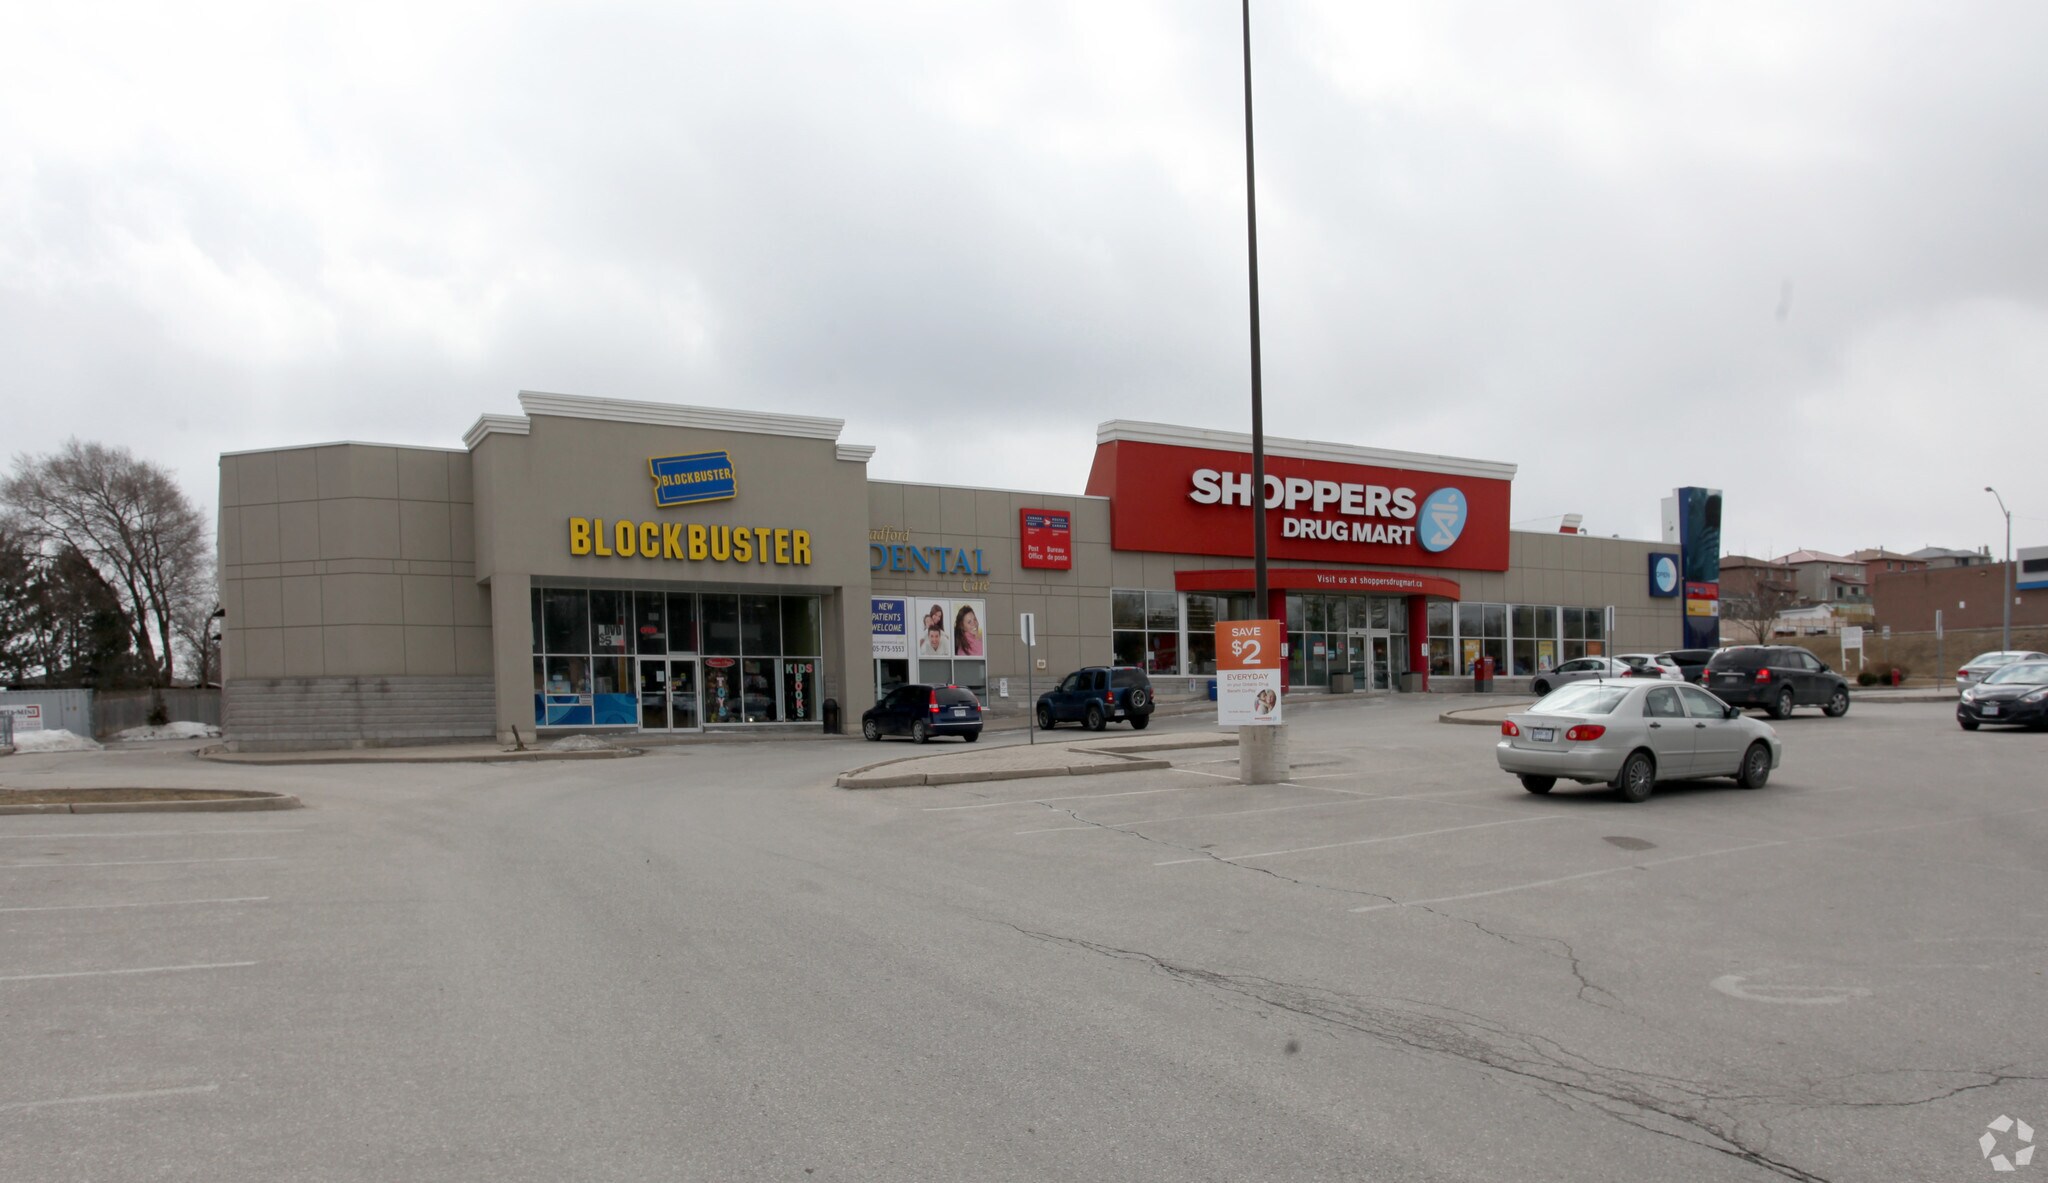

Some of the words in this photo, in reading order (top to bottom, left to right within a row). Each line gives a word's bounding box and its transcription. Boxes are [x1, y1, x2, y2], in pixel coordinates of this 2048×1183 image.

[662, 468, 731, 487] BLOCKBUSTER
[1190, 469, 1417, 519] SHOPPERS
[869, 525, 912, 542] adford
[1283, 518, 1349, 541] DRUG
[1351, 523, 1415, 545] MART
[570, 517, 812, 565] BLOCKBUSTER
[1028, 544, 1039, 552] Post
[1028, 552, 1043, 560] Office
[1047, 545, 1064, 553] Bureau
[869, 543, 991, 575] DENTAL
[962, 577, 990, 592] Care
[1317, 574, 1335, 583] Visit
[1338, 576, 1347, 584] us
[1350, 576, 1357, 584] at
[1360, 577, 1423, 588] shoppersdrugmart.ca
[878, 602, 894, 611] NEW
[872, 613, 901, 621] PATIENTS
[604, 624, 622, 636] DVD
[872, 623, 902, 632] WELCOME
[1232, 627, 1261, 636] SAVE
[600, 633, 612, 646] $5
[1231, 639, 1261, 664] $2
[786, 663, 813, 674] KIDS
[716, 677, 727, 717] TOYS
[795, 673, 805, 718] BOOKS
